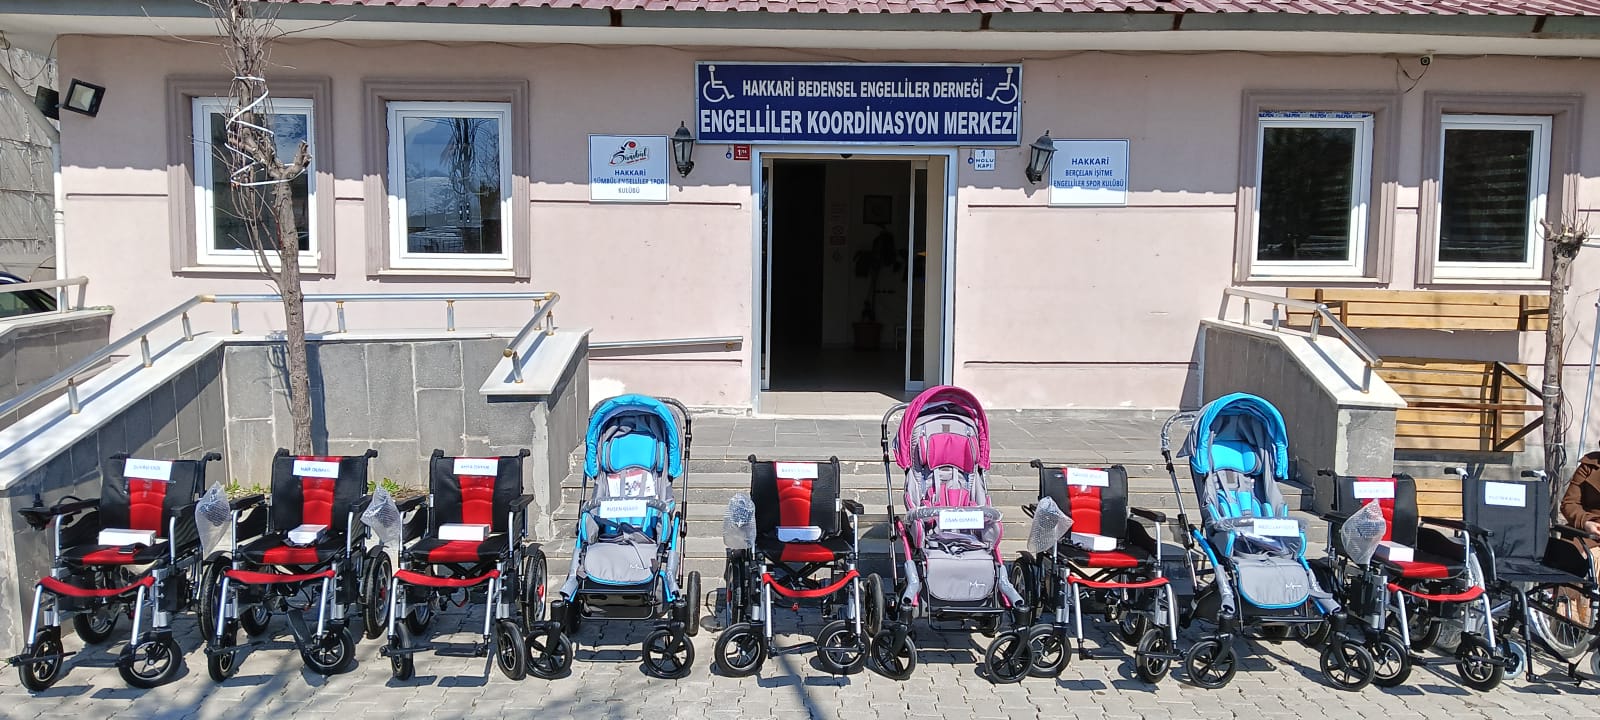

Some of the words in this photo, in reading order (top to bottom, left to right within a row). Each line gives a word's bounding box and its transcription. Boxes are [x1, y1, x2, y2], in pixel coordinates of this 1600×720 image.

[742, 76, 795, 97] HAKKARİ
[798, 80, 858, 98] BEDENSEL
[860, 77, 930, 98] ENGELLİLER
[933, 78, 983, 98] DERNEĞİ
[700, 104, 803, 133] ENGELLİLER
[807, 105, 939, 135] KOORDİNASYON
[944, 106, 1018, 135] MERKEZİ
[1071, 157, 1110, 166] HAKKARİ
[614, 169, 647, 177] HAKKARİ
[1065, 168, 1093, 178] BERÇELAN
[1094, 167, 1113, 178] İŞİTME
[1053, 179, 1085, 188] ENGELLİLER
[1086, 180, 1101, 188] SPOR
[1102, 179, 1124, 188] KULÜBÜ
